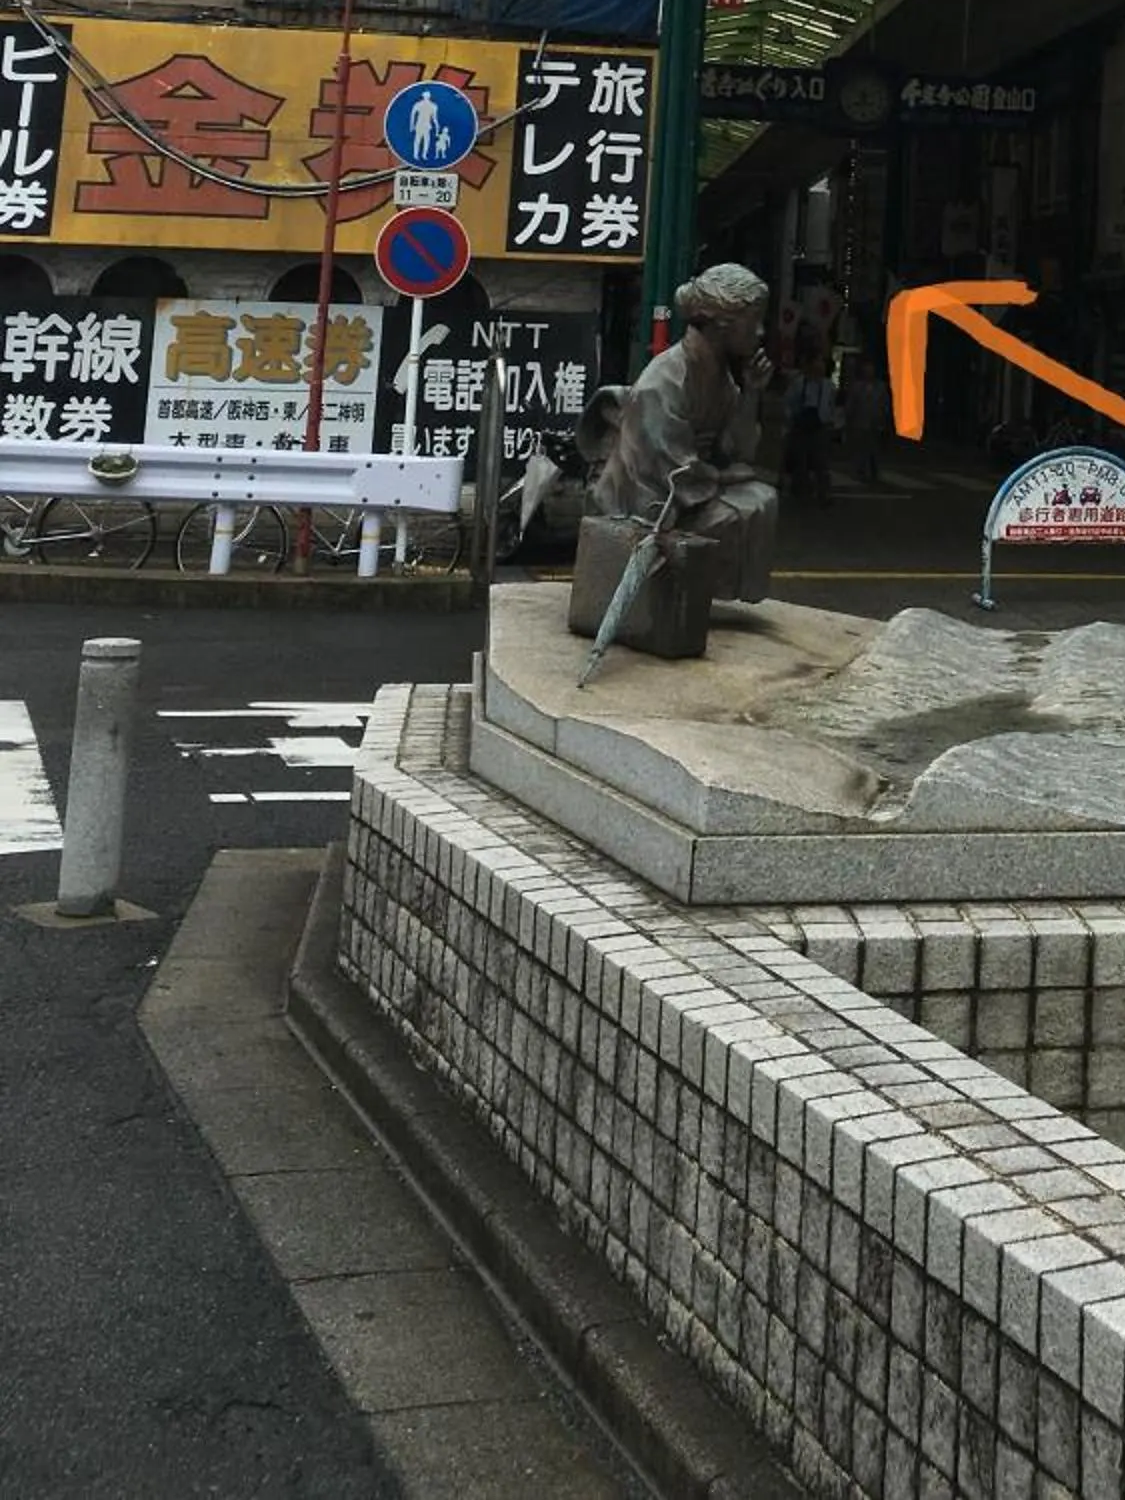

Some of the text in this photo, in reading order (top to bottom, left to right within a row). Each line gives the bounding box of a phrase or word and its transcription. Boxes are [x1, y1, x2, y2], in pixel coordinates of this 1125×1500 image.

[73, 53, 498, 223] 金券
[514, 60, 580, 247] テレカ
[580, 62, 649, 249] 旅行券
[0, 311, 142, 384] 幹線
[166, 310, 375, 386] 高速券
[471, 321, 550, 349] NTT
[1, 394, 113, 443] 数券
